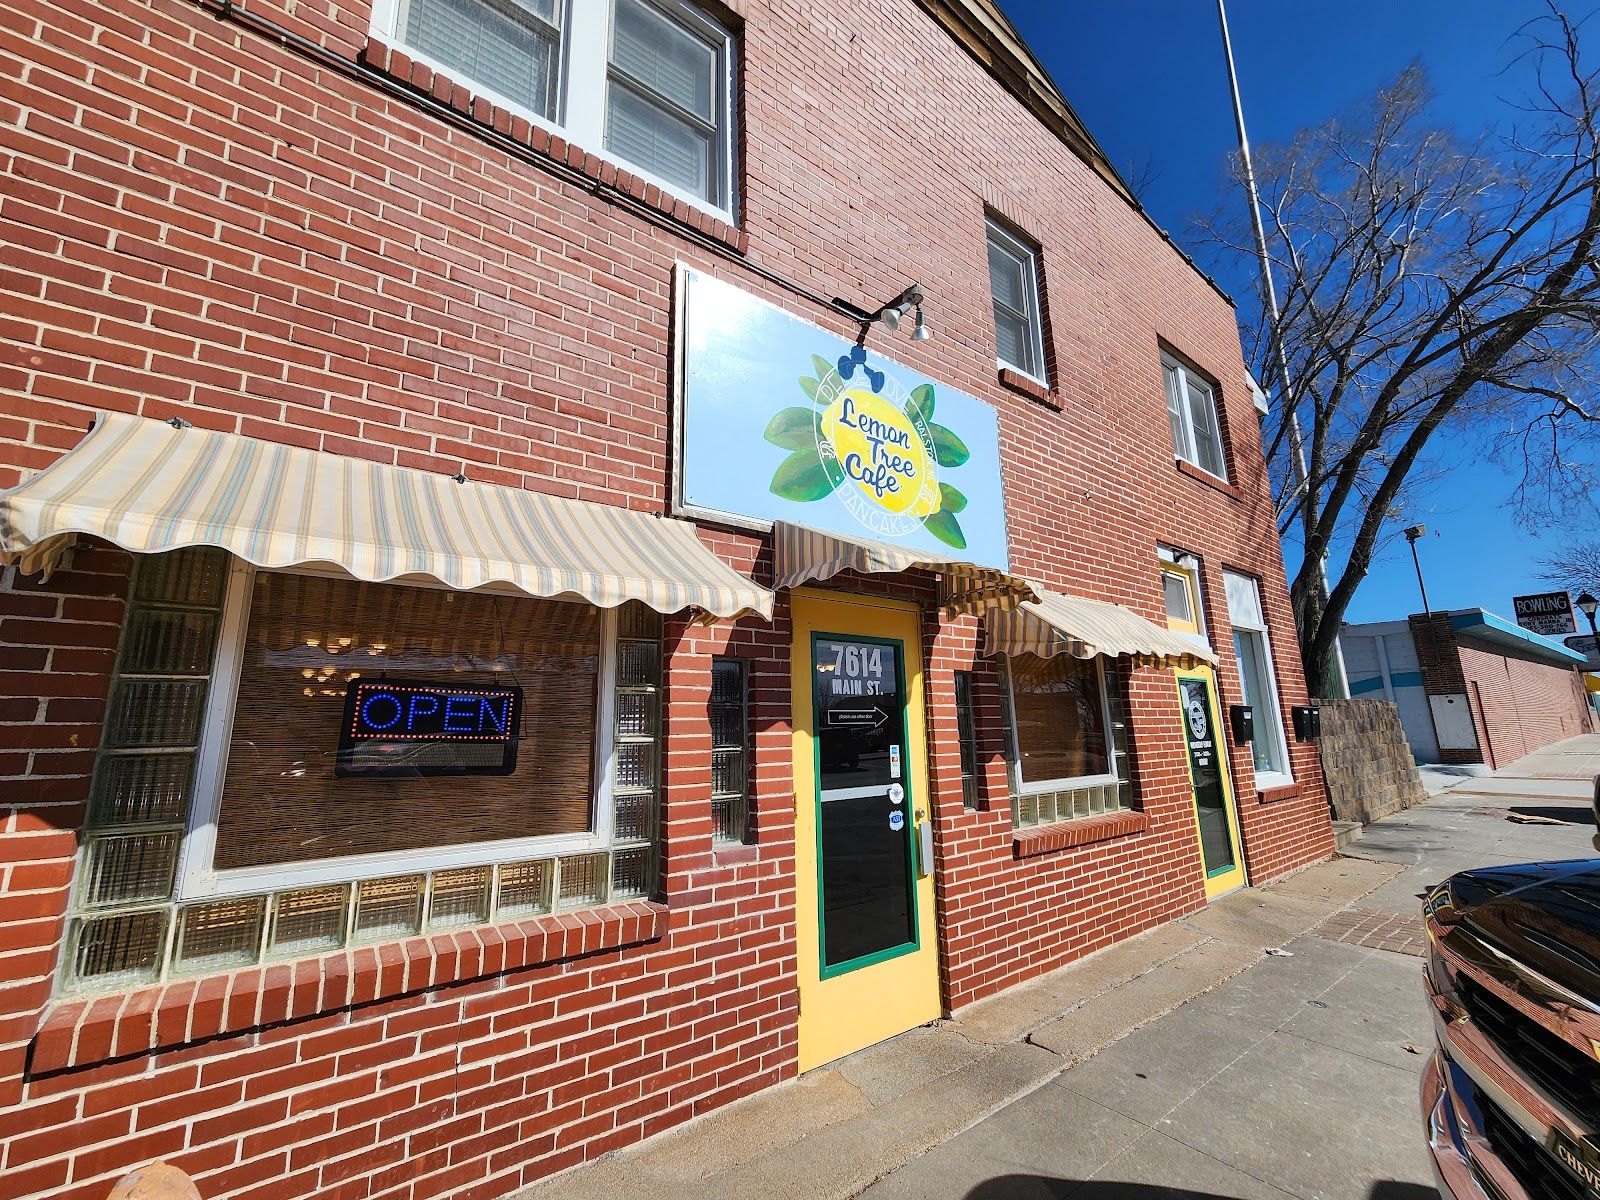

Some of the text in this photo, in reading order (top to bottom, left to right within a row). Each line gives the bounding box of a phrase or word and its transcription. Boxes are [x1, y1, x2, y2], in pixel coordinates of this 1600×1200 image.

[839, 398, 911, 450] Lemon
[845, 453, 900, 498] Cafe
[866, 436, 916, 478] Tree
[836, 481, 920, 535] PANCAKES
[1516, 596, 1567, 614] BOWLING
[831, 645, 883, 679] 7614
[832, 679, 884, 696] MAIN ST.
[362, 693, 509, 732] OPEN
